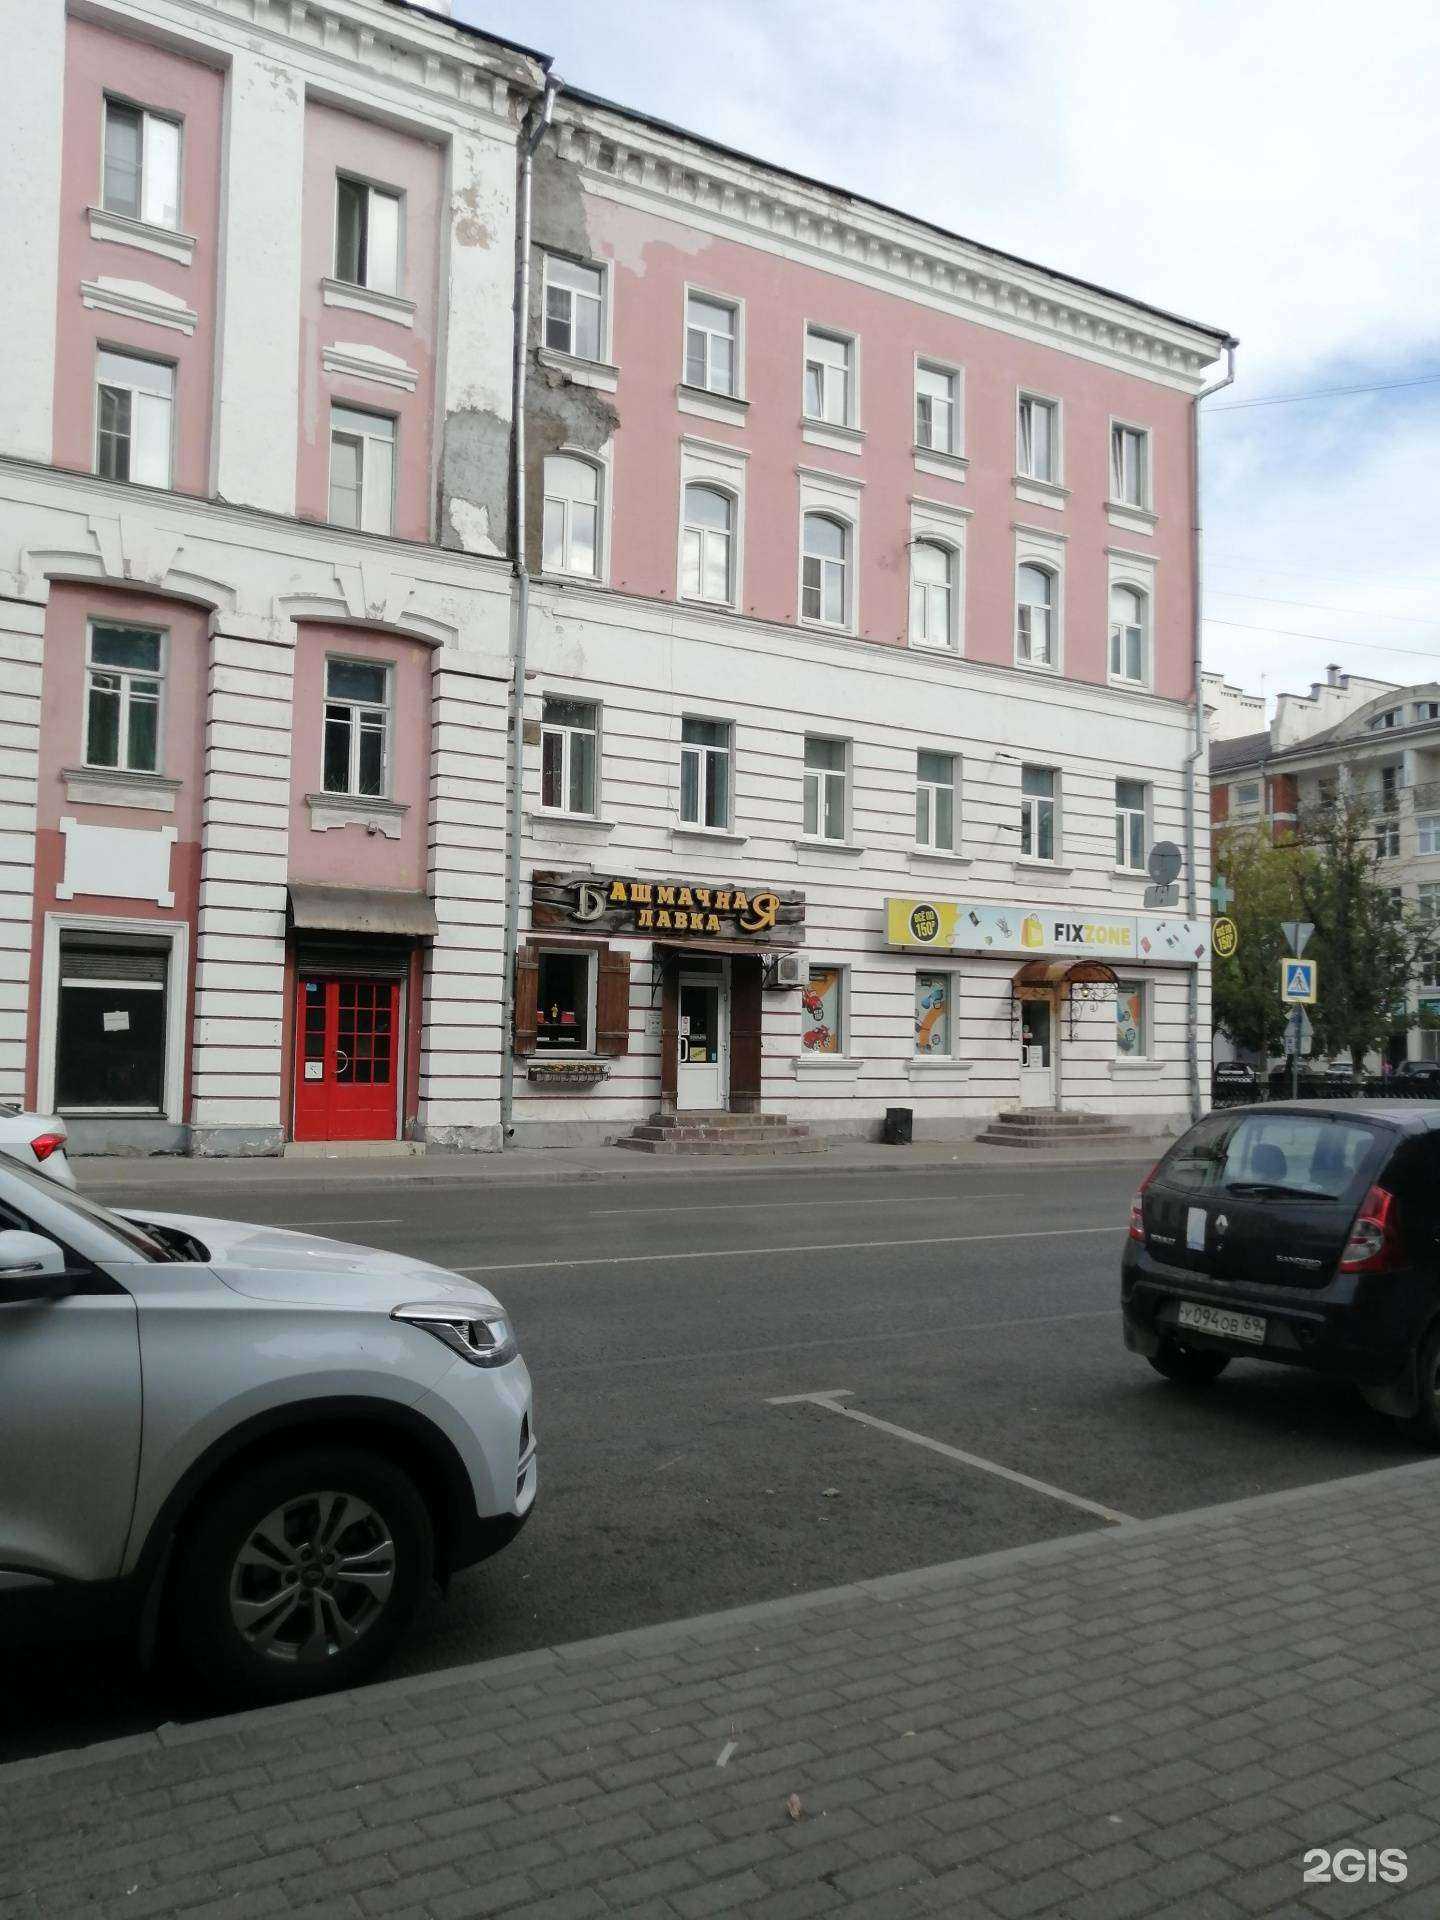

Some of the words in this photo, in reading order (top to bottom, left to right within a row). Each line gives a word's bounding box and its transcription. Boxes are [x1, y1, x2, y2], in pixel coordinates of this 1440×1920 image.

[568, 880, 780, 932] БАШМАЧНАЯ
[638, 909, 720, 931] ЛАВКА
[1054, 923, 1131, 945] FIXZONE
